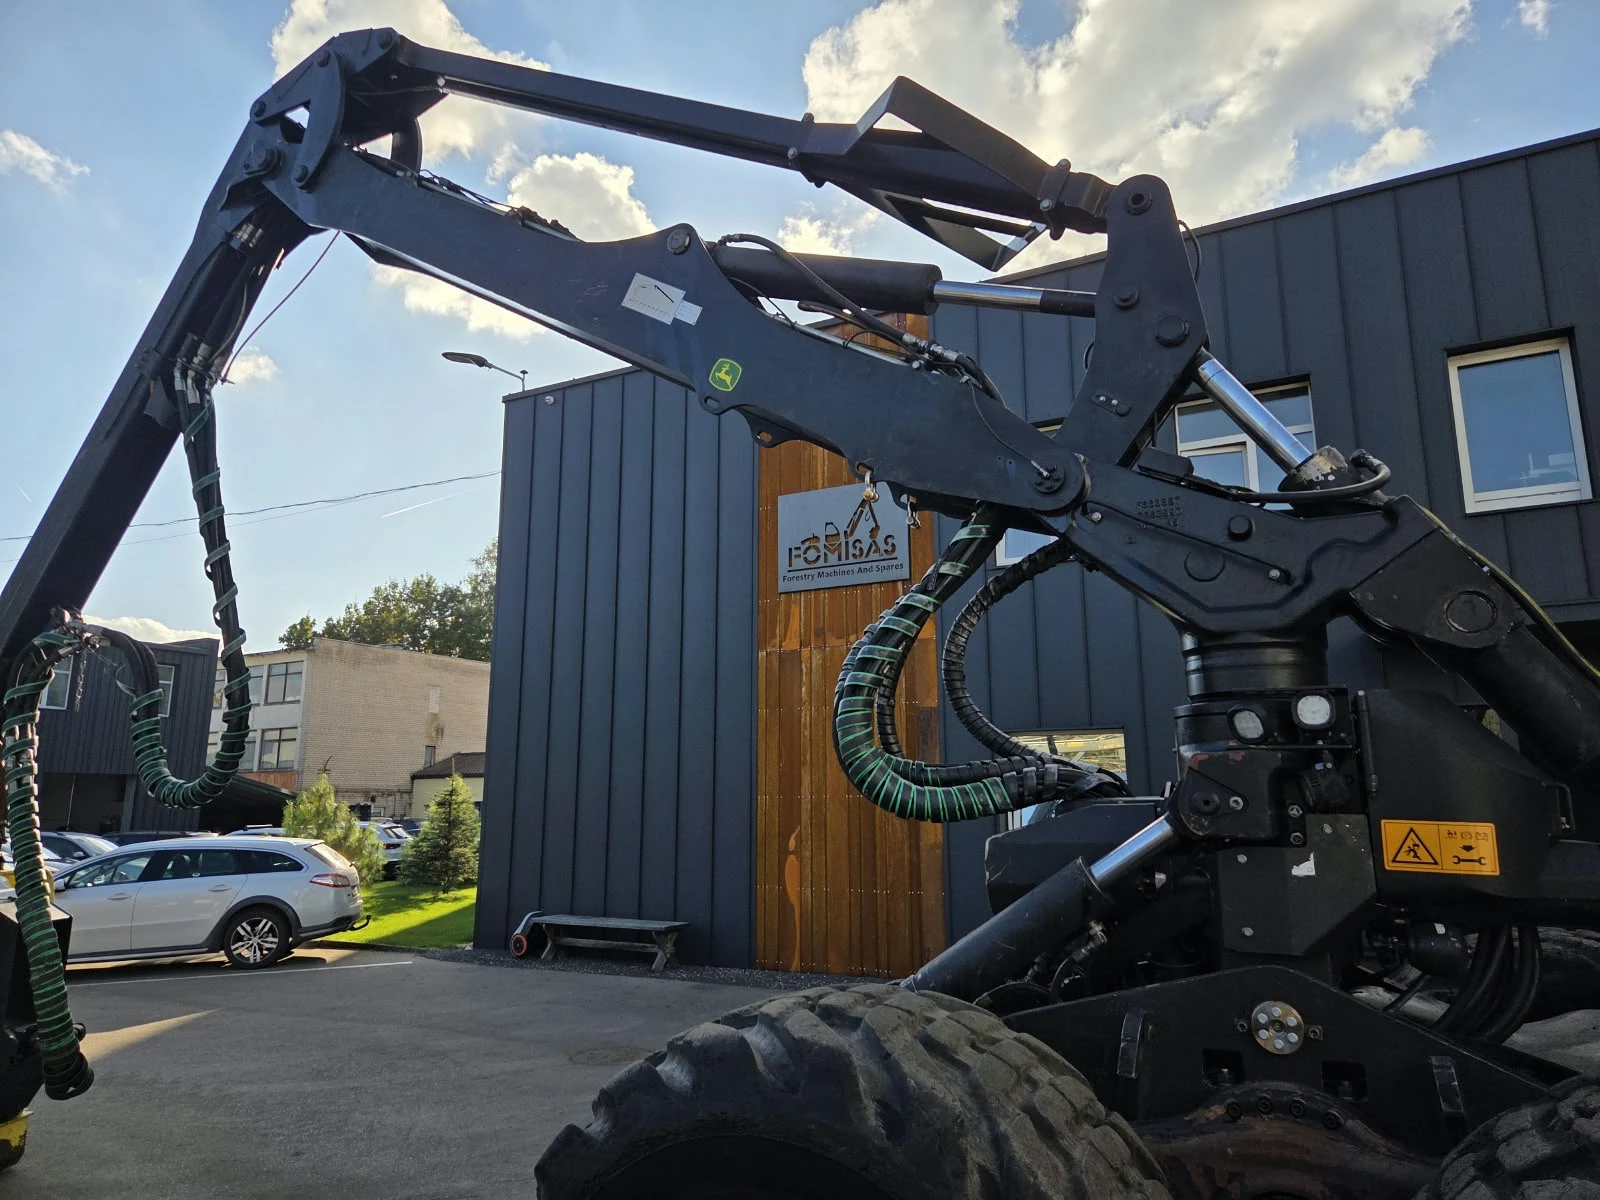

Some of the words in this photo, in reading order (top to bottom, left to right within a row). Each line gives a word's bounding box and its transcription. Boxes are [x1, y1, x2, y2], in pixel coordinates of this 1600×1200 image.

[788, 534, 897, 568] FOMISAS
[782, 573, 815, 583] Forestry
[817, 569, 855, 579] Machines
[856, 565, 874, 575] And
[876, 562, 904, 573] Spares
